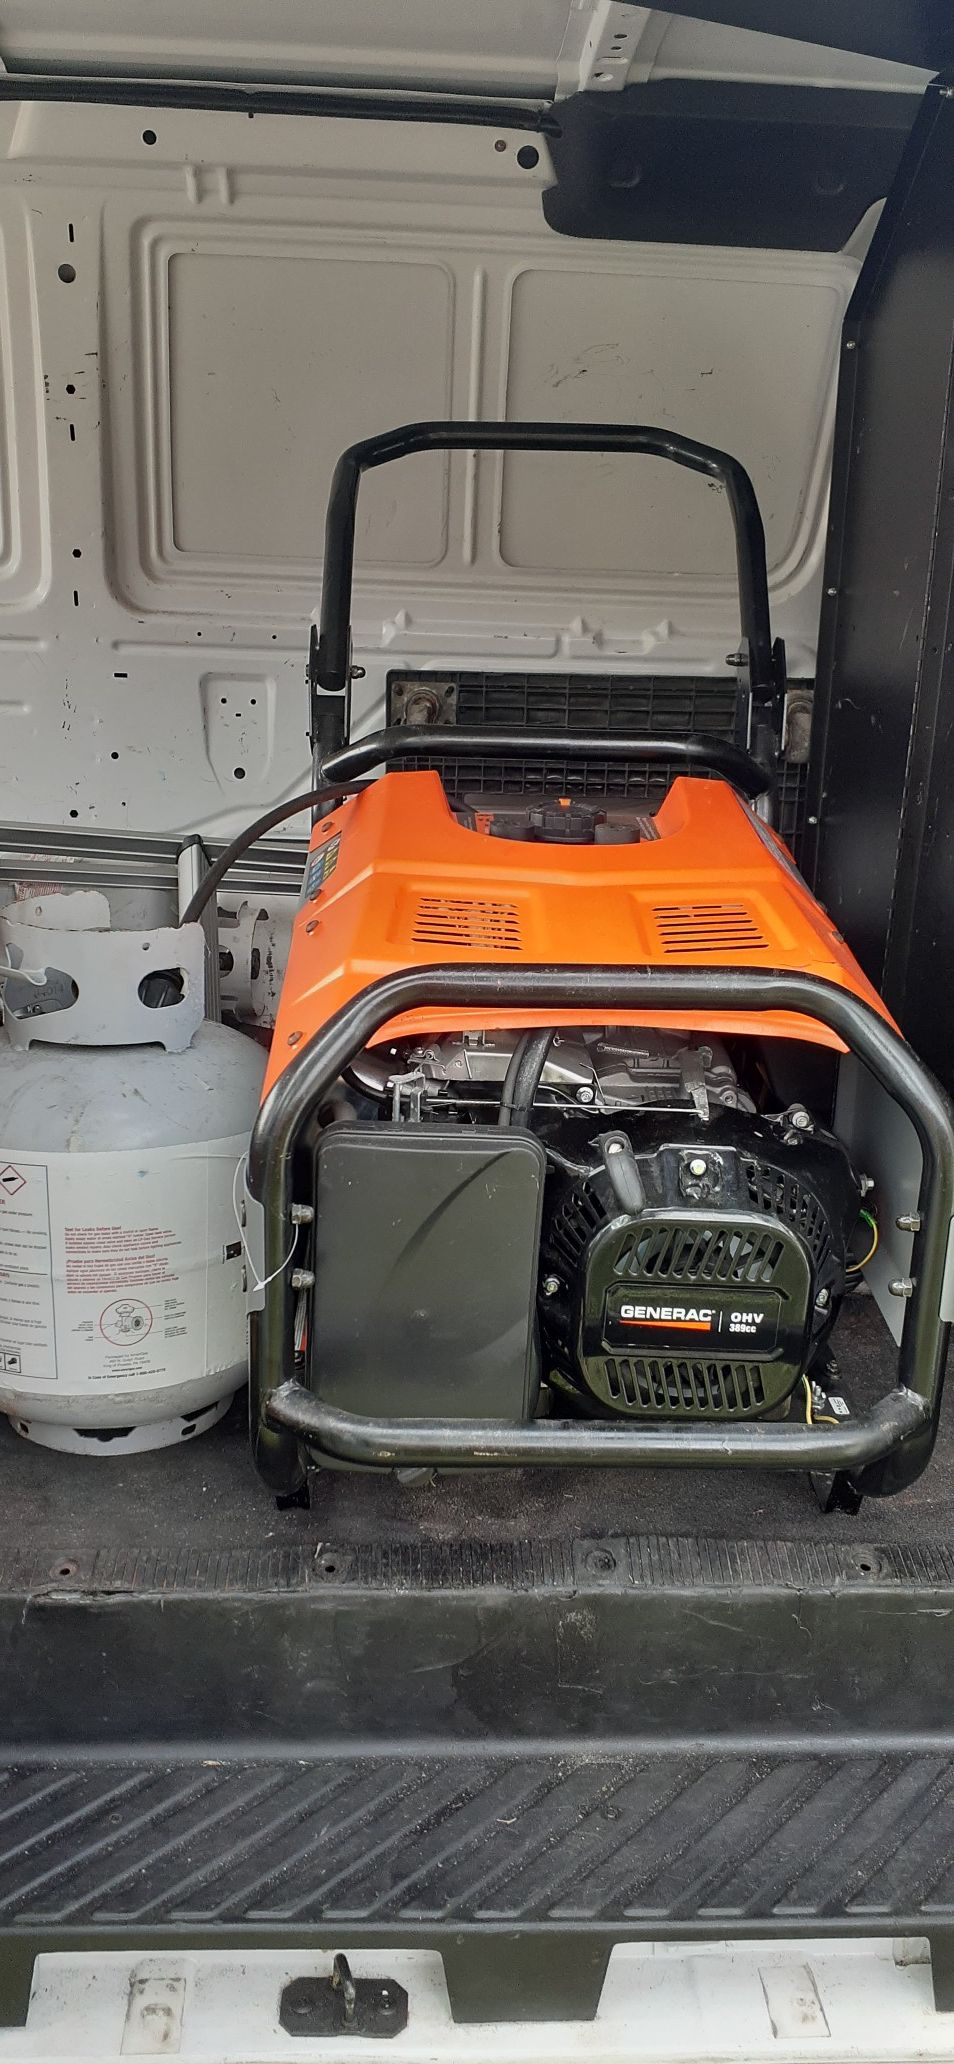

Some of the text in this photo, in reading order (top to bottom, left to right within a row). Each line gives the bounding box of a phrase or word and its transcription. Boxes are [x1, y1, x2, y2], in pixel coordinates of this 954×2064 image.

[620, 1305, 713, 1321] GENERAC
[731, 1312, 764, 1324] OHV
[729, 1323, 757, 1334] 389cc
